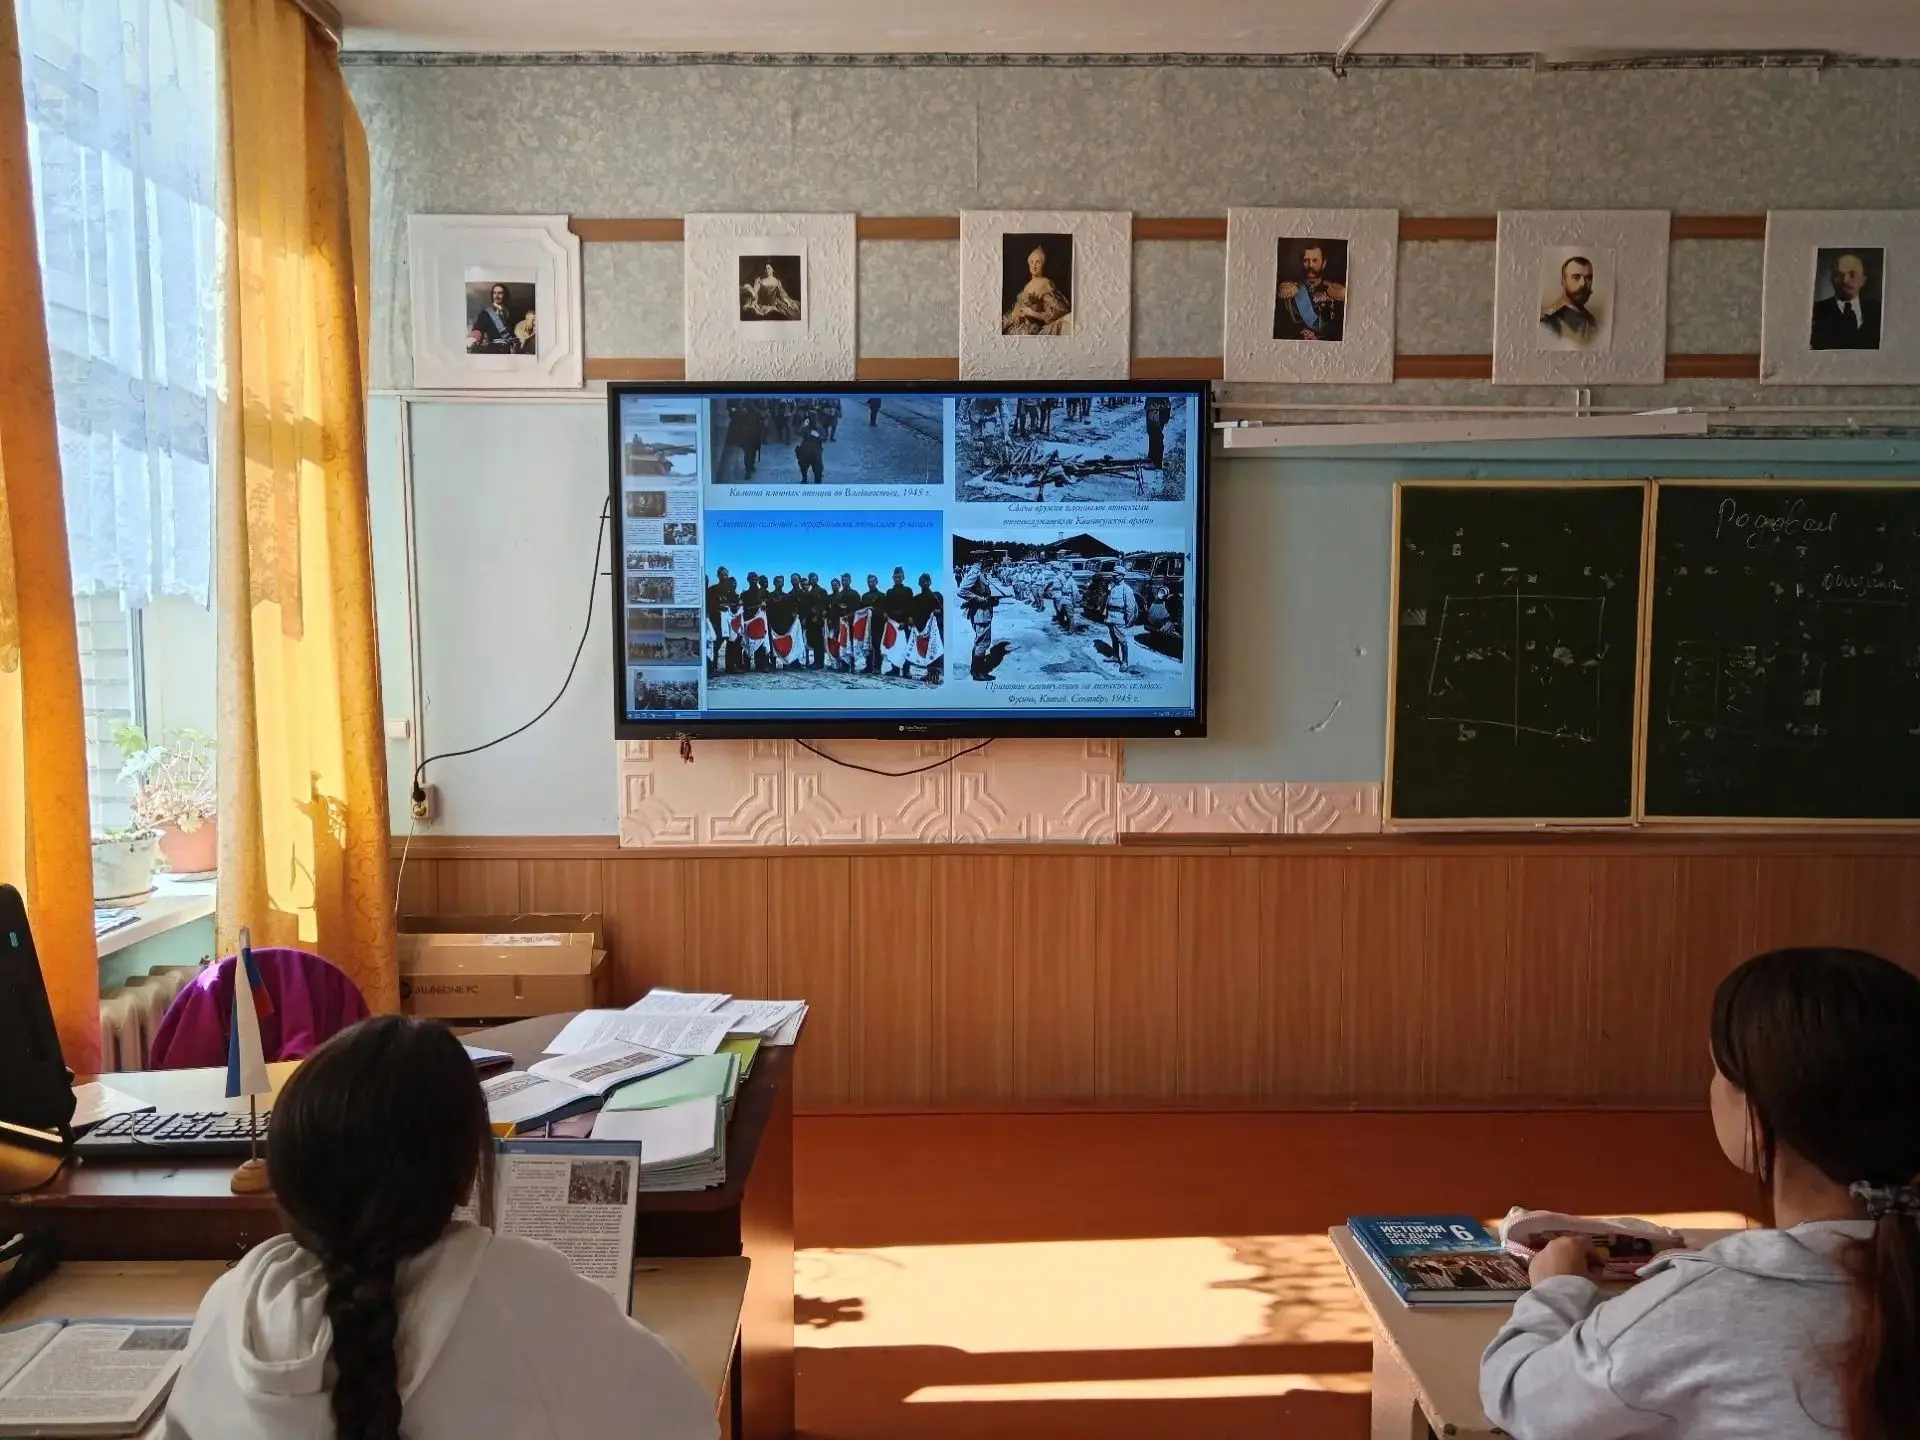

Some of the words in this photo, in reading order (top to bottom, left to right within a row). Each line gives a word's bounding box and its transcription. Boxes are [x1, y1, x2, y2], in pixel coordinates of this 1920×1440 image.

[902, 487, 925, 497] 1945
[1111, 693, 1133, 703] 1945
[1380, 1225, 1447, 1233] ИСТОРИЯ
[1449, 1224, 1475, 1241] 6
[1385, 1232, 1444, 1240] СРЕДНИХ
